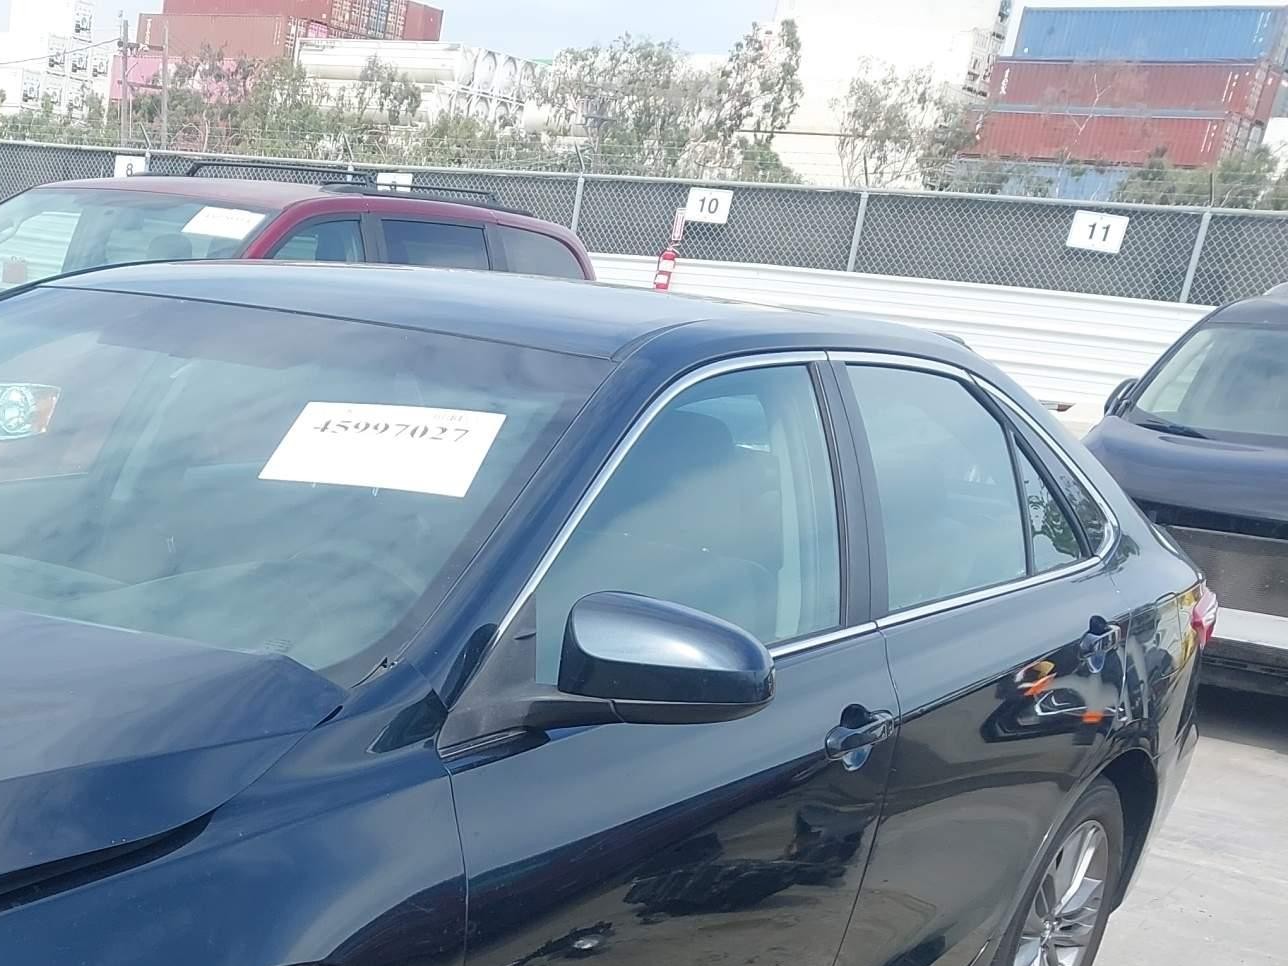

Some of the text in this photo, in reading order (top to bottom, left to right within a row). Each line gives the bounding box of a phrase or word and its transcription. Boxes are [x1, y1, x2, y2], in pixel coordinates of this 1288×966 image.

[126, 162, 133, 177] 8
[699, 196, 719, 214] 10
[1088, 222, 1111, 242] 11
[313, 418, 470, 443] 45997027
